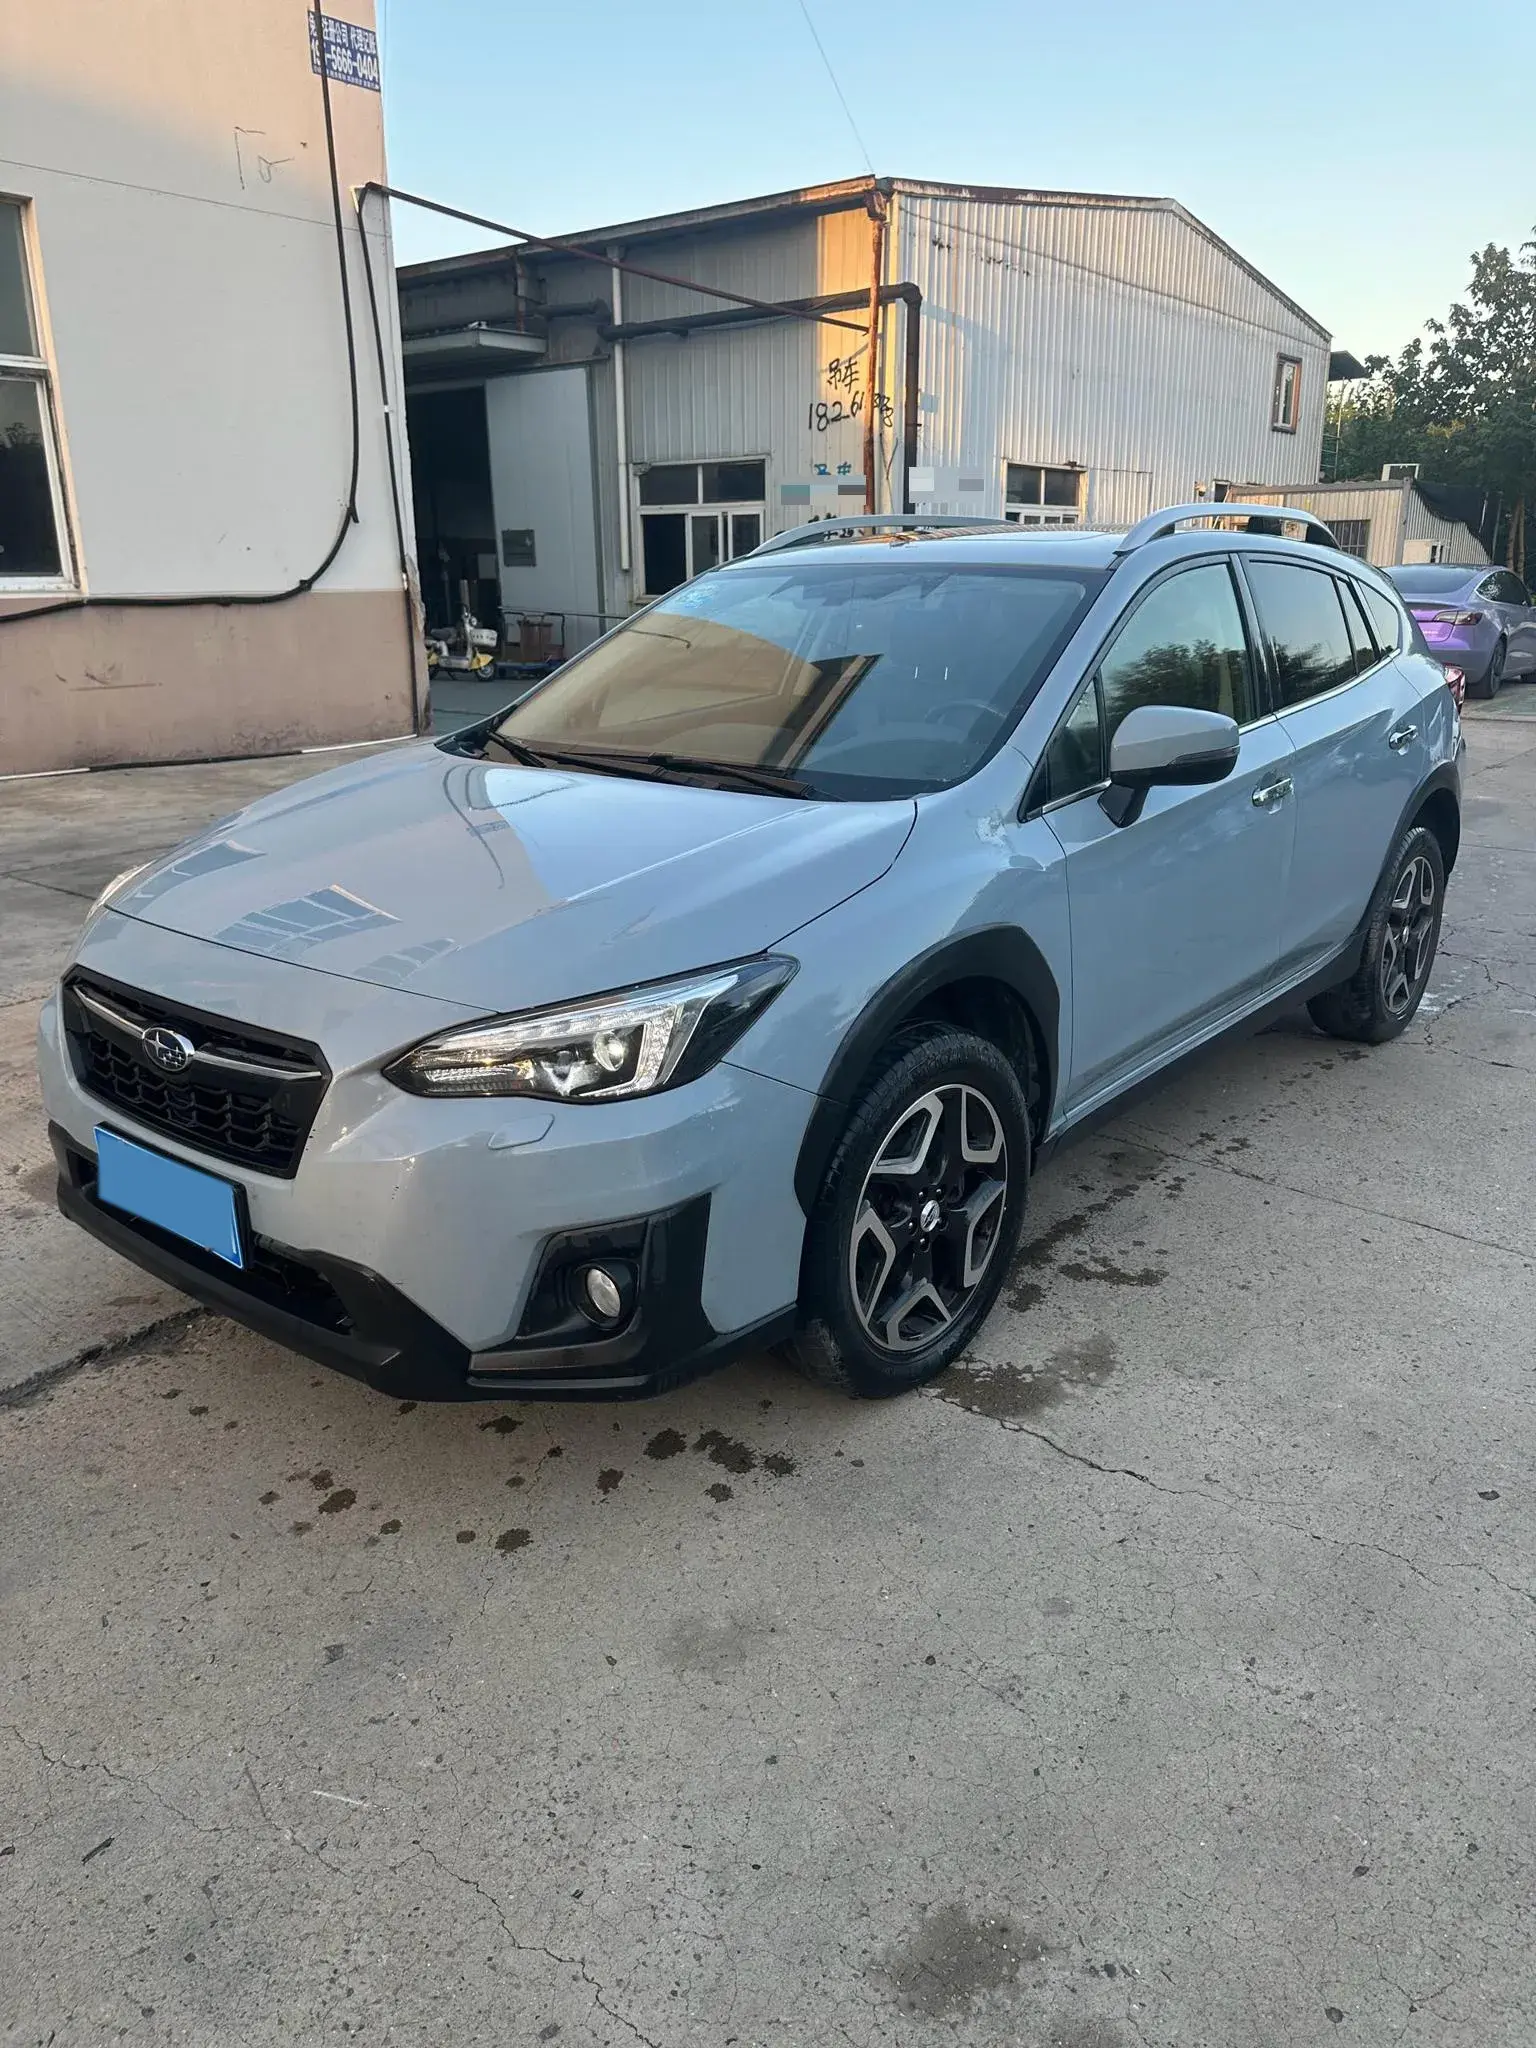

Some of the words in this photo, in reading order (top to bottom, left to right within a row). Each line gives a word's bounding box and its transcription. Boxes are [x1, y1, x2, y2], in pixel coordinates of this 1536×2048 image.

[309, 12, 348, 47] 免注册公司
